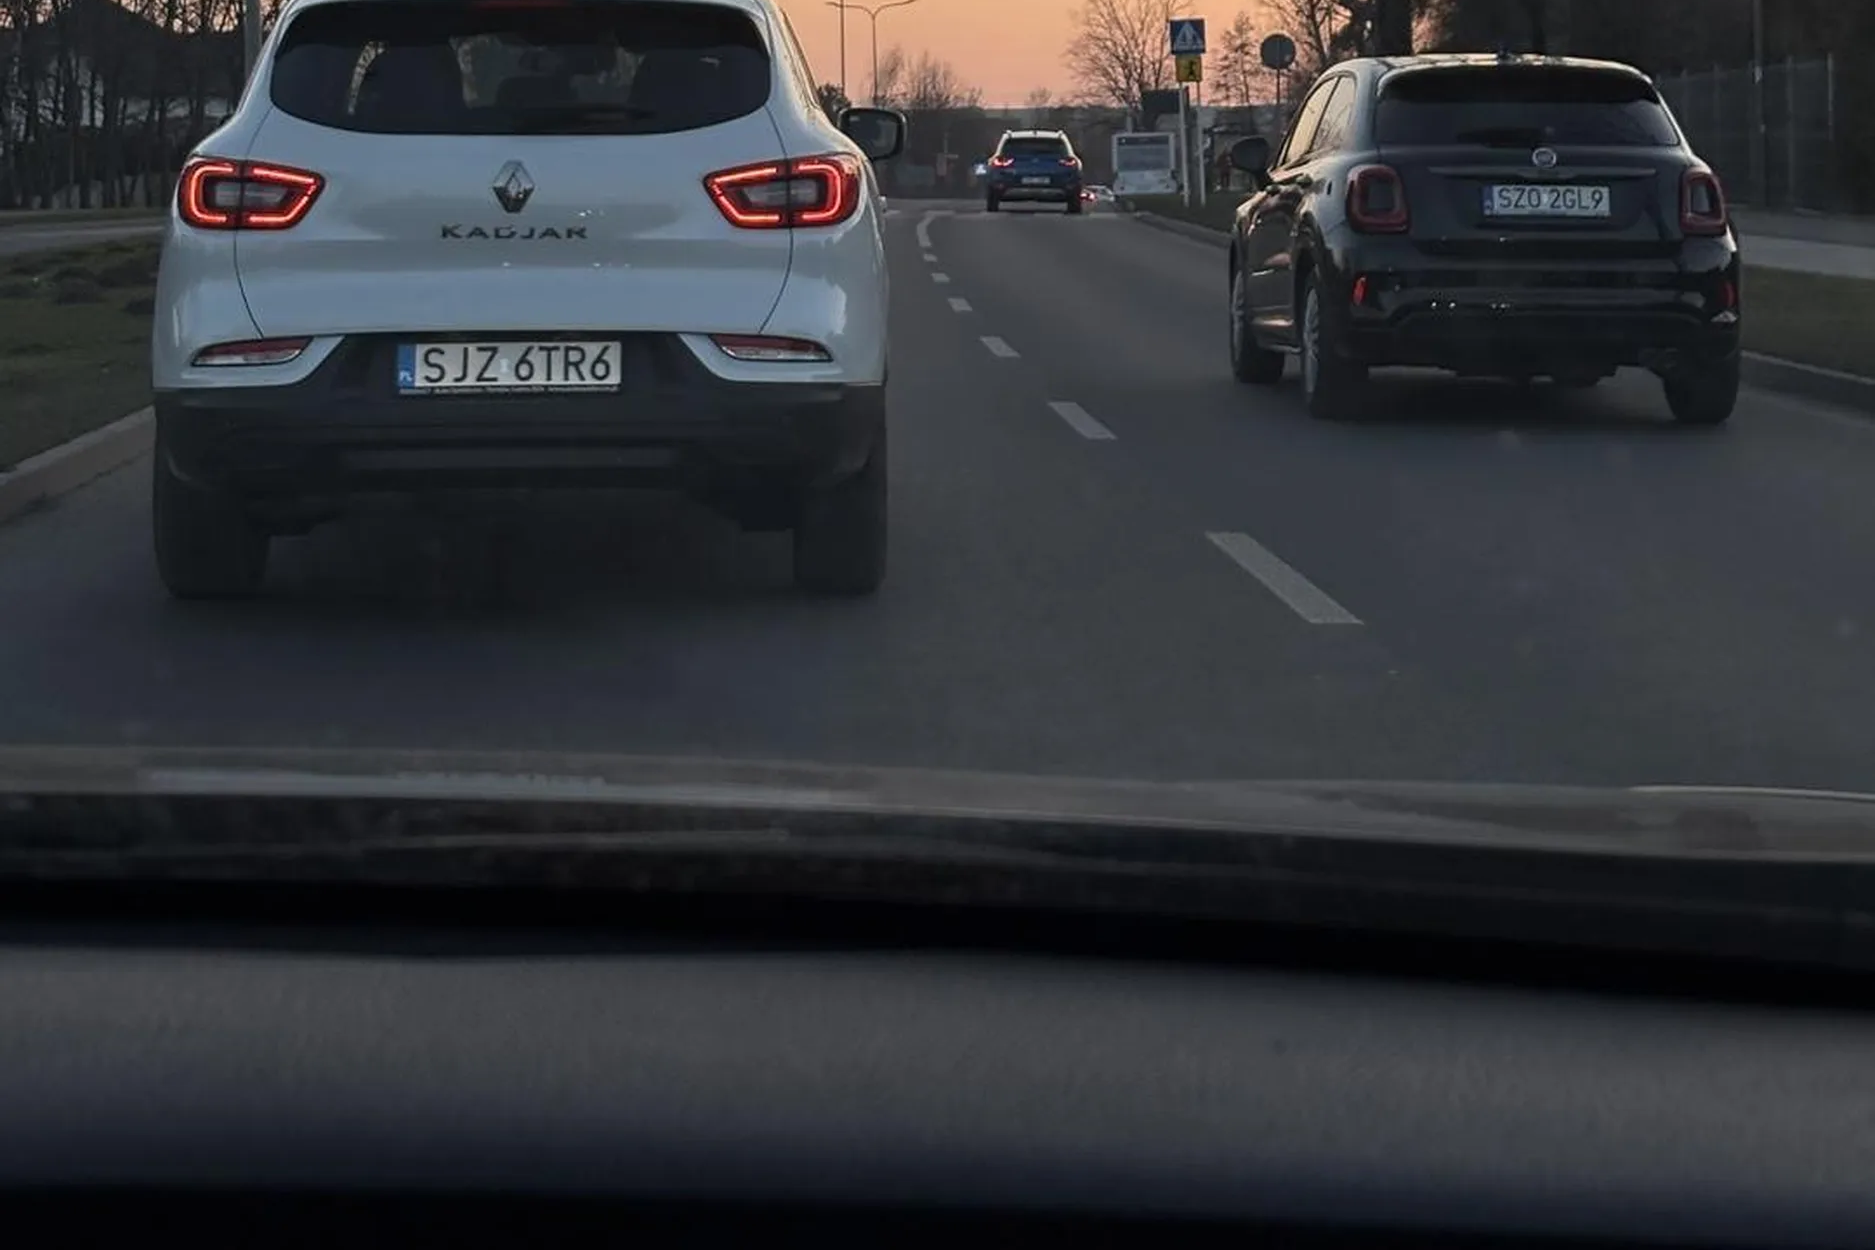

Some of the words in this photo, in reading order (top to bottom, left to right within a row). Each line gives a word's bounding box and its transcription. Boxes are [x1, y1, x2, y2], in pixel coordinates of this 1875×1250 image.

[1550, 188, 1604, 210] 2GL9
[440, 224, 589, 240] KADJAR
[423, 346, 500, 384] SJZ
[514, 345, 612, 382] 6TR6
